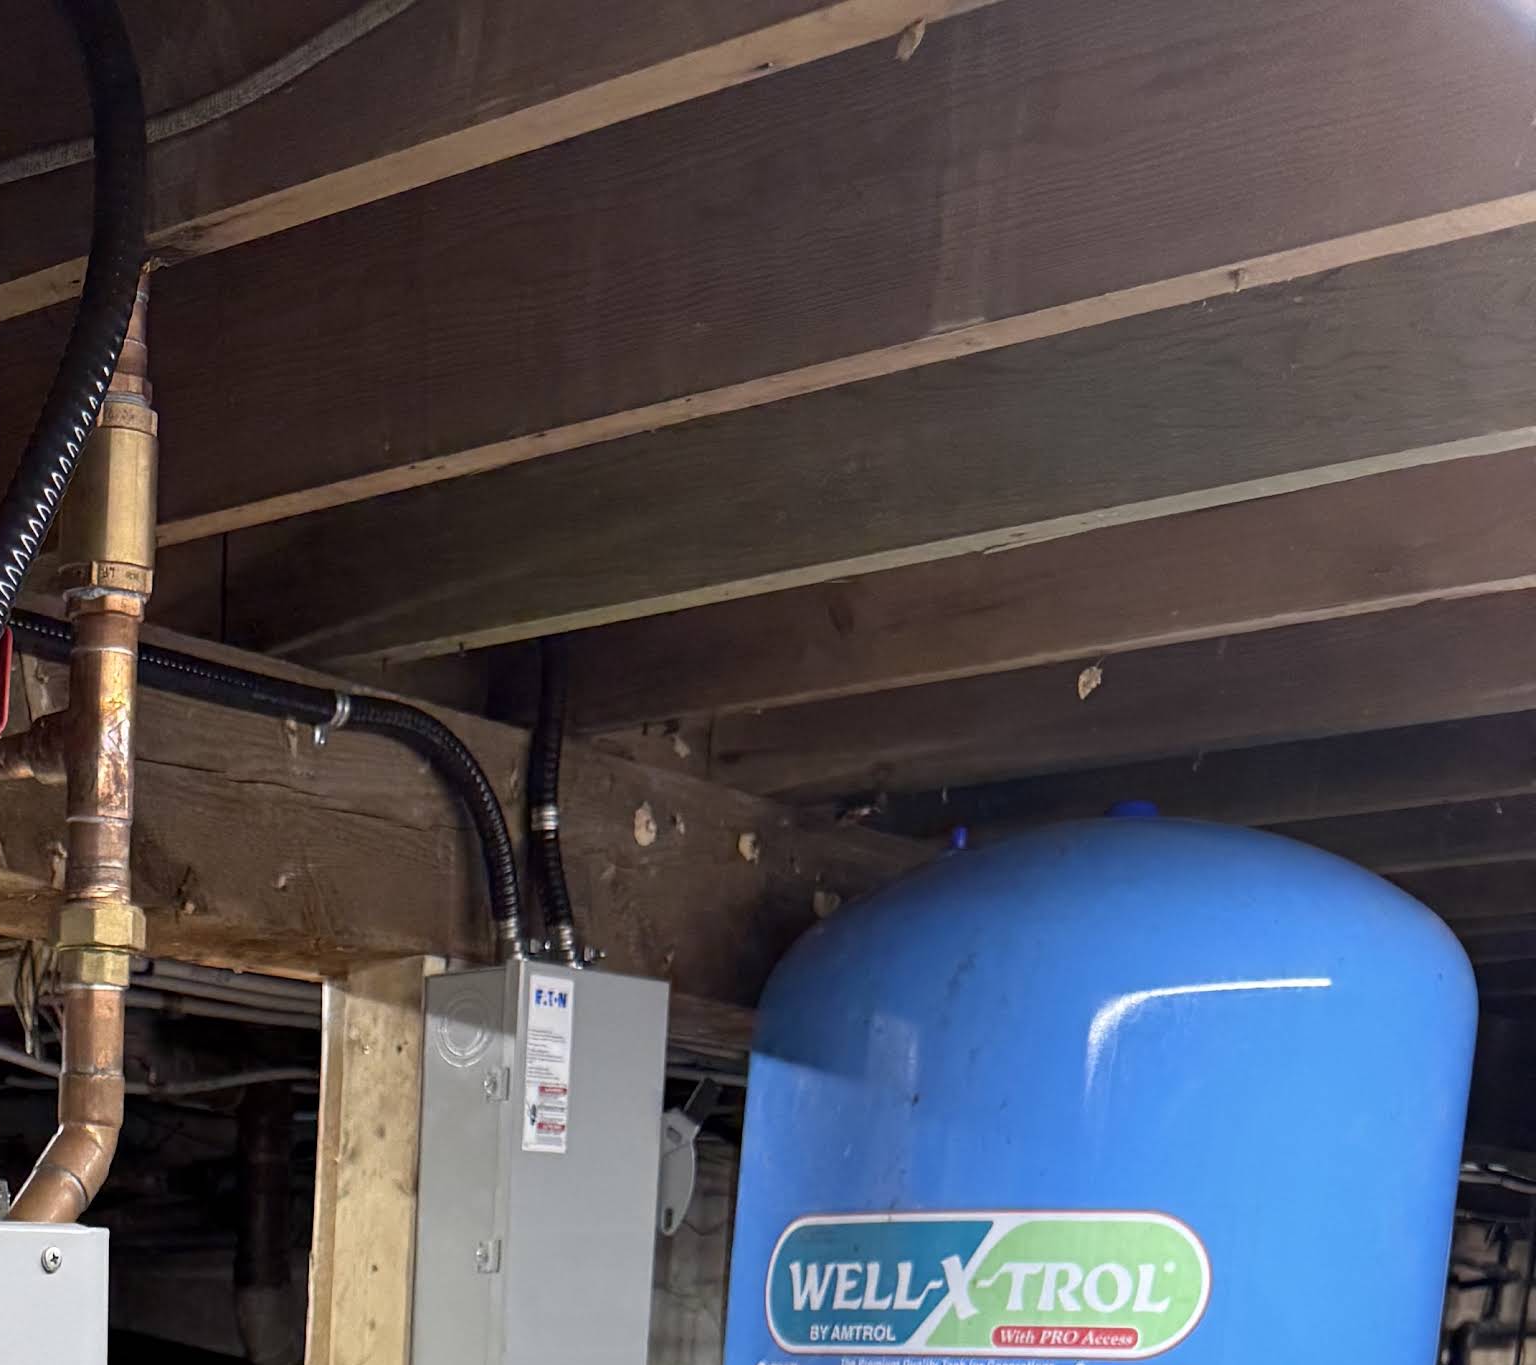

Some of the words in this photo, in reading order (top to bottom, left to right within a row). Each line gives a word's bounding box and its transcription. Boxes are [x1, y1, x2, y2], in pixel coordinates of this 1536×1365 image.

[810, 1325, 825, 1342] BY
[831, 1325, 896, 1343] AMTROL
[999, 1329, 1035, 1345] With
[1040, 1329, 1078, 1346] PRO
[1080, 1331, 1133, 1346] Access
